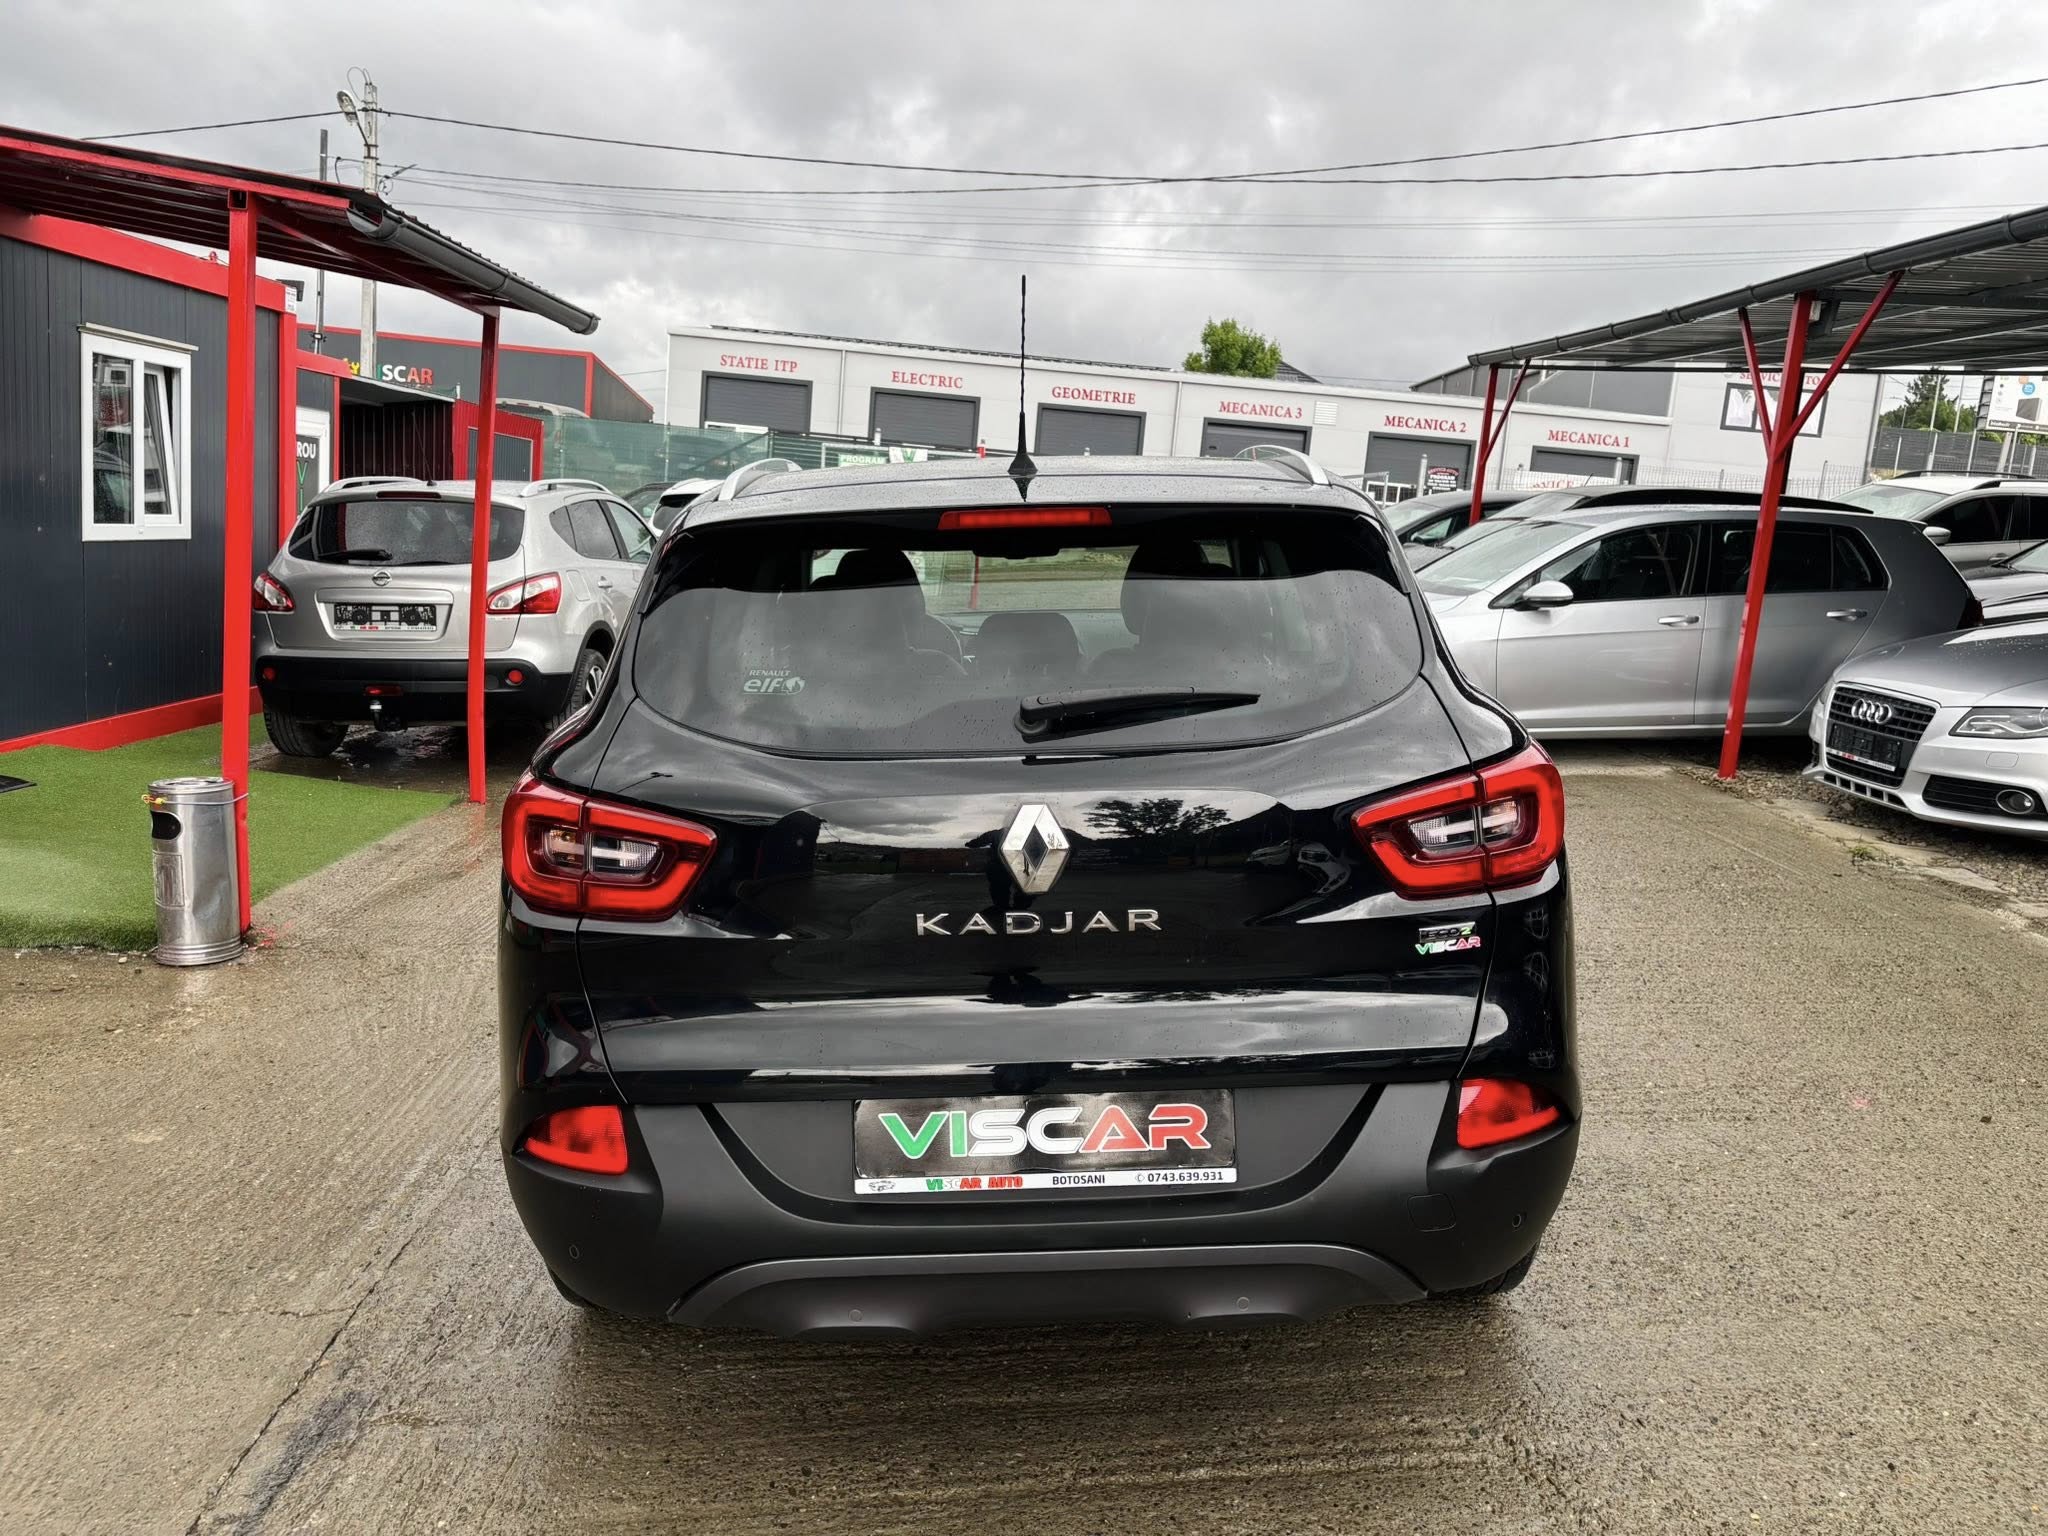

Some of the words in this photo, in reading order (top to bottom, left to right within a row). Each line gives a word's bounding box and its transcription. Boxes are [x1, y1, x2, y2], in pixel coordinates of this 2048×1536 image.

[720, 354, 768, 370] STATIE
[774, 359, 798, 372] ITP
[377, 364, 433, 385] ISCAR
[892, 370, 963, 388] ELECTRIC
[1051, 386, 1136, 404] GEOMETRIE
[1219, 401, 1293, 418] MECANICA
[1295, 407, 1303, 418] 3
[1384, 415, 1457, 432] MECANICA
[1459, 422, 1467, 433] 2
[1548, 430, 1622, 447] MECANICA
[1625, 436, 1630, 448] 1
[743, 678, 784, 693] elf
[916, 909, 1162, 936] KADJAR
[1415, 936, 1481, 955] VISCAR
[878, 1103, 1212, 1160] VISCAR
[926, 1177, 982, 1191] VISCAR
[988, 1175, 1023, 1188] AUTO
[1052, 1174, 1106, 1186] BOTOSANI
[1147, 1171, 1224, 1183] 0743.639.931
